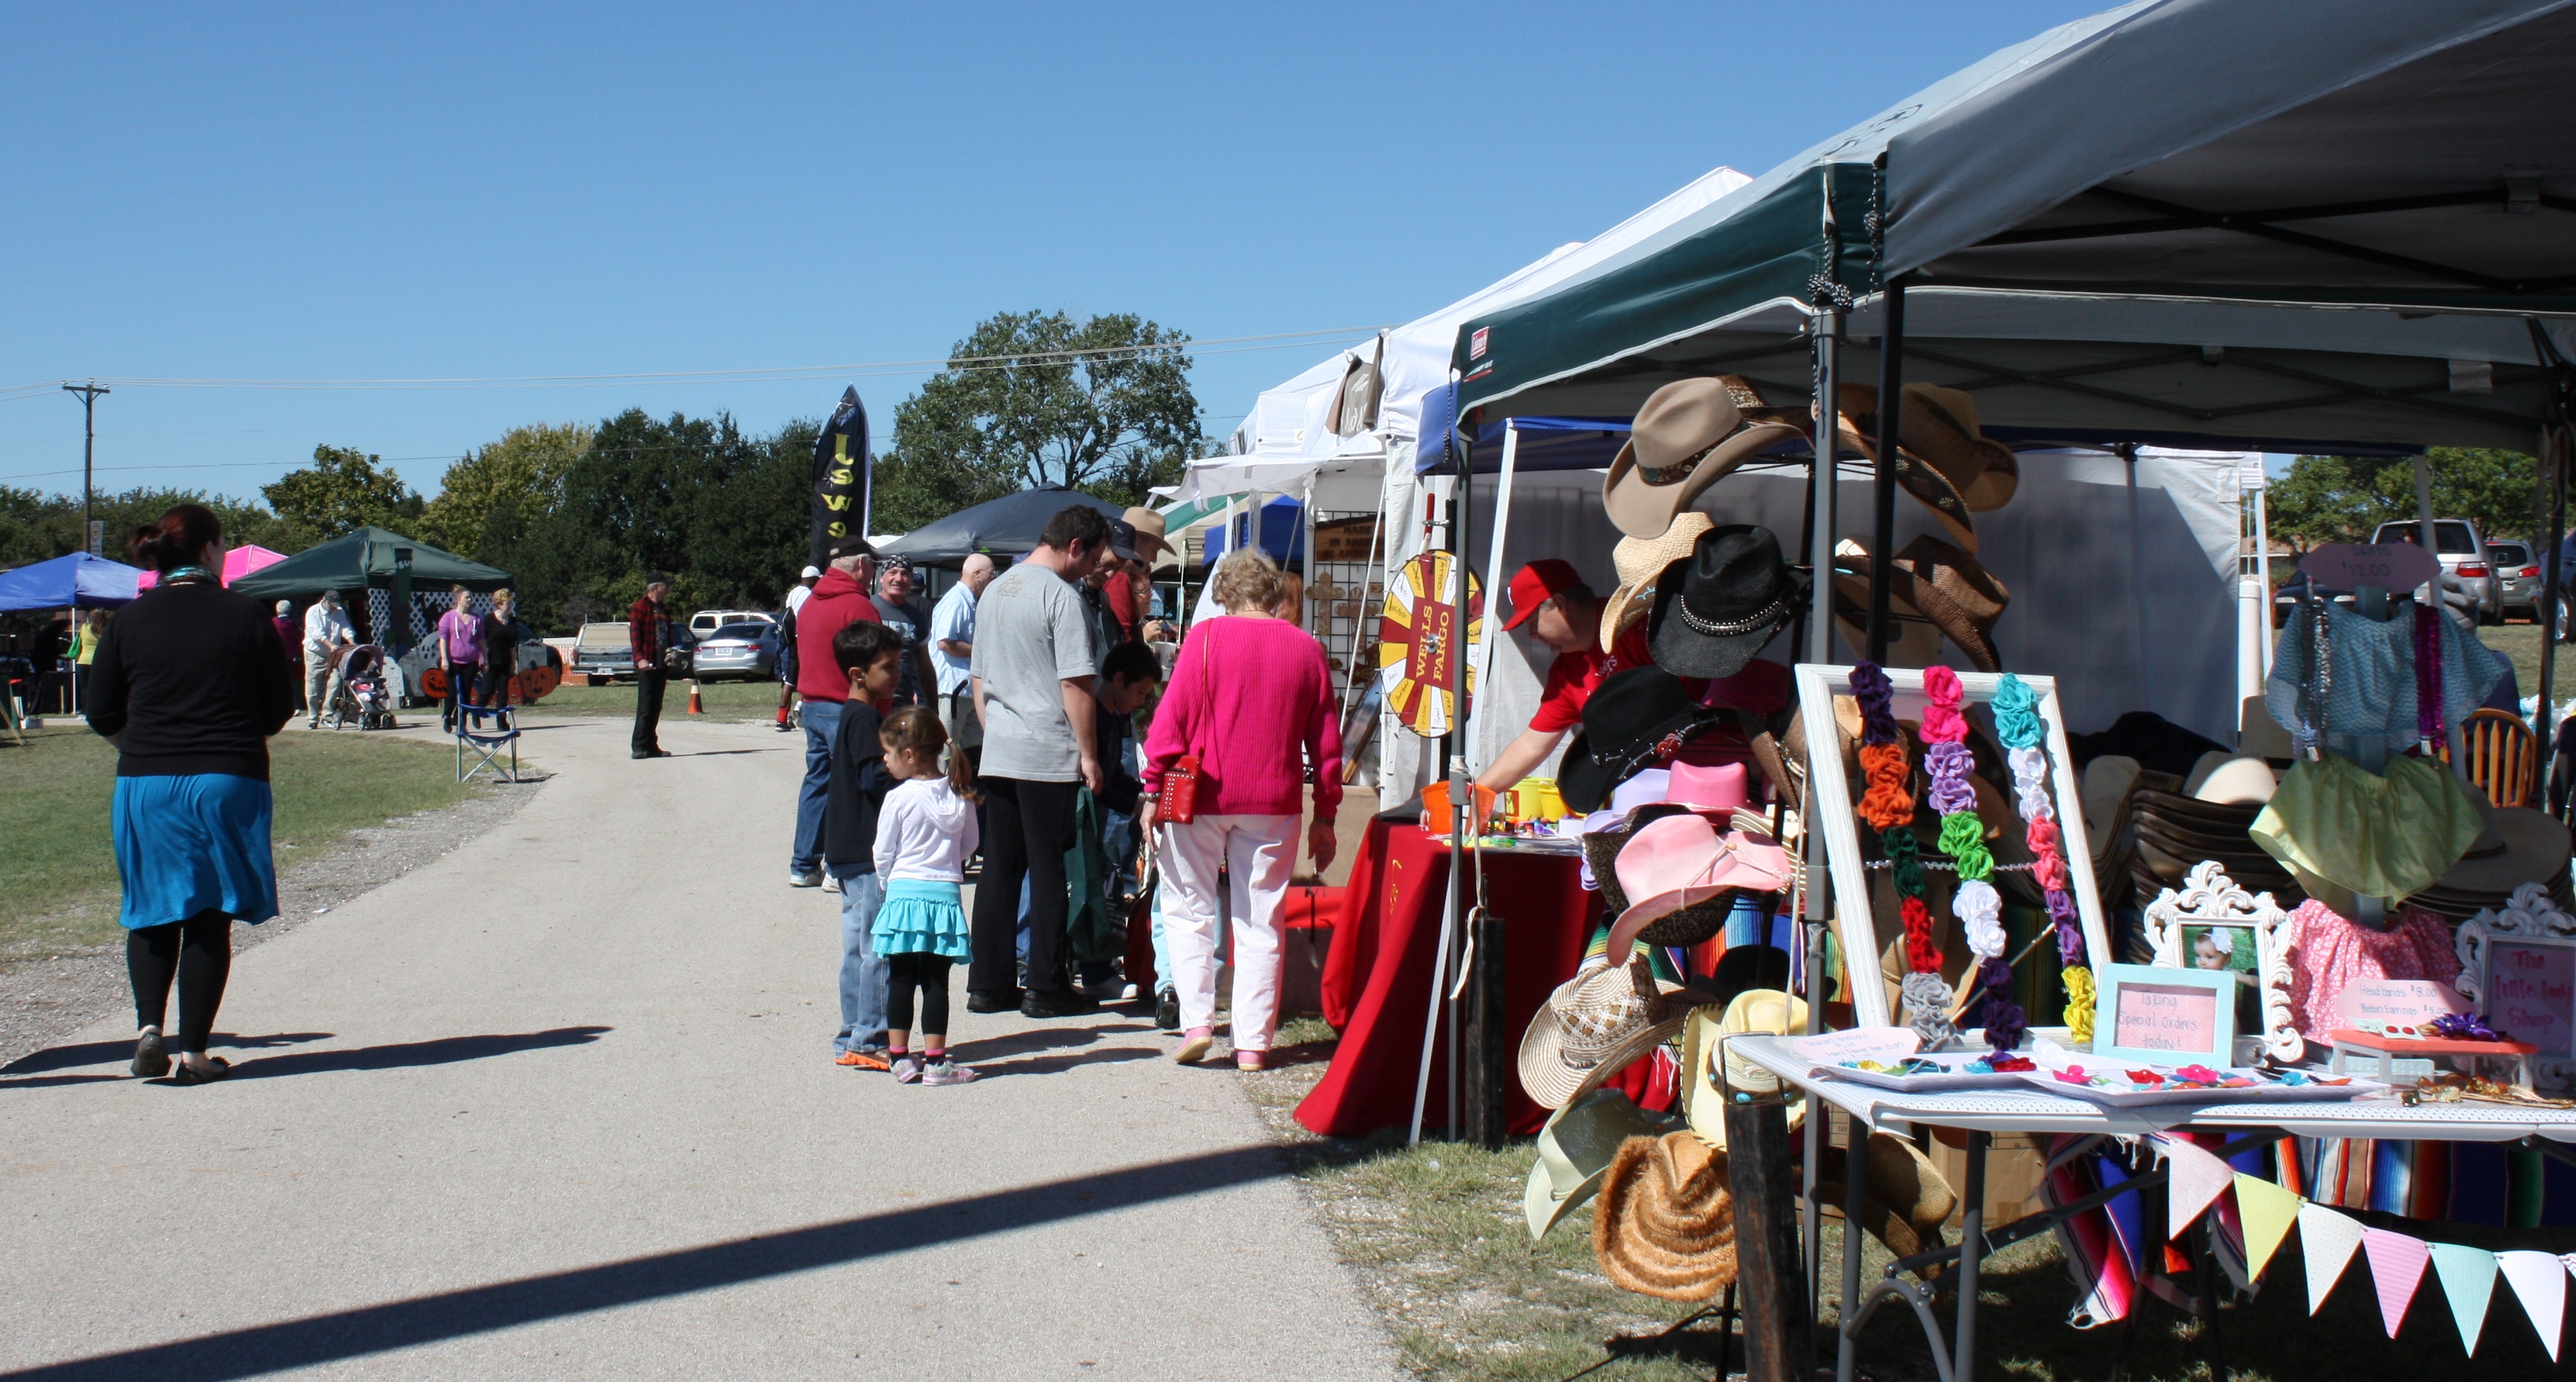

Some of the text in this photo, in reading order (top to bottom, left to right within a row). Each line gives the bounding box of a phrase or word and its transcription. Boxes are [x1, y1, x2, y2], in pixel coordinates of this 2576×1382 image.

[1416, 606, 1432, 678] WELLS
[1433, 611, 1449, 681] FARGO
[2510, 950, 2545, 969] The
[2507, 1007, 2554, 1034] Shop
